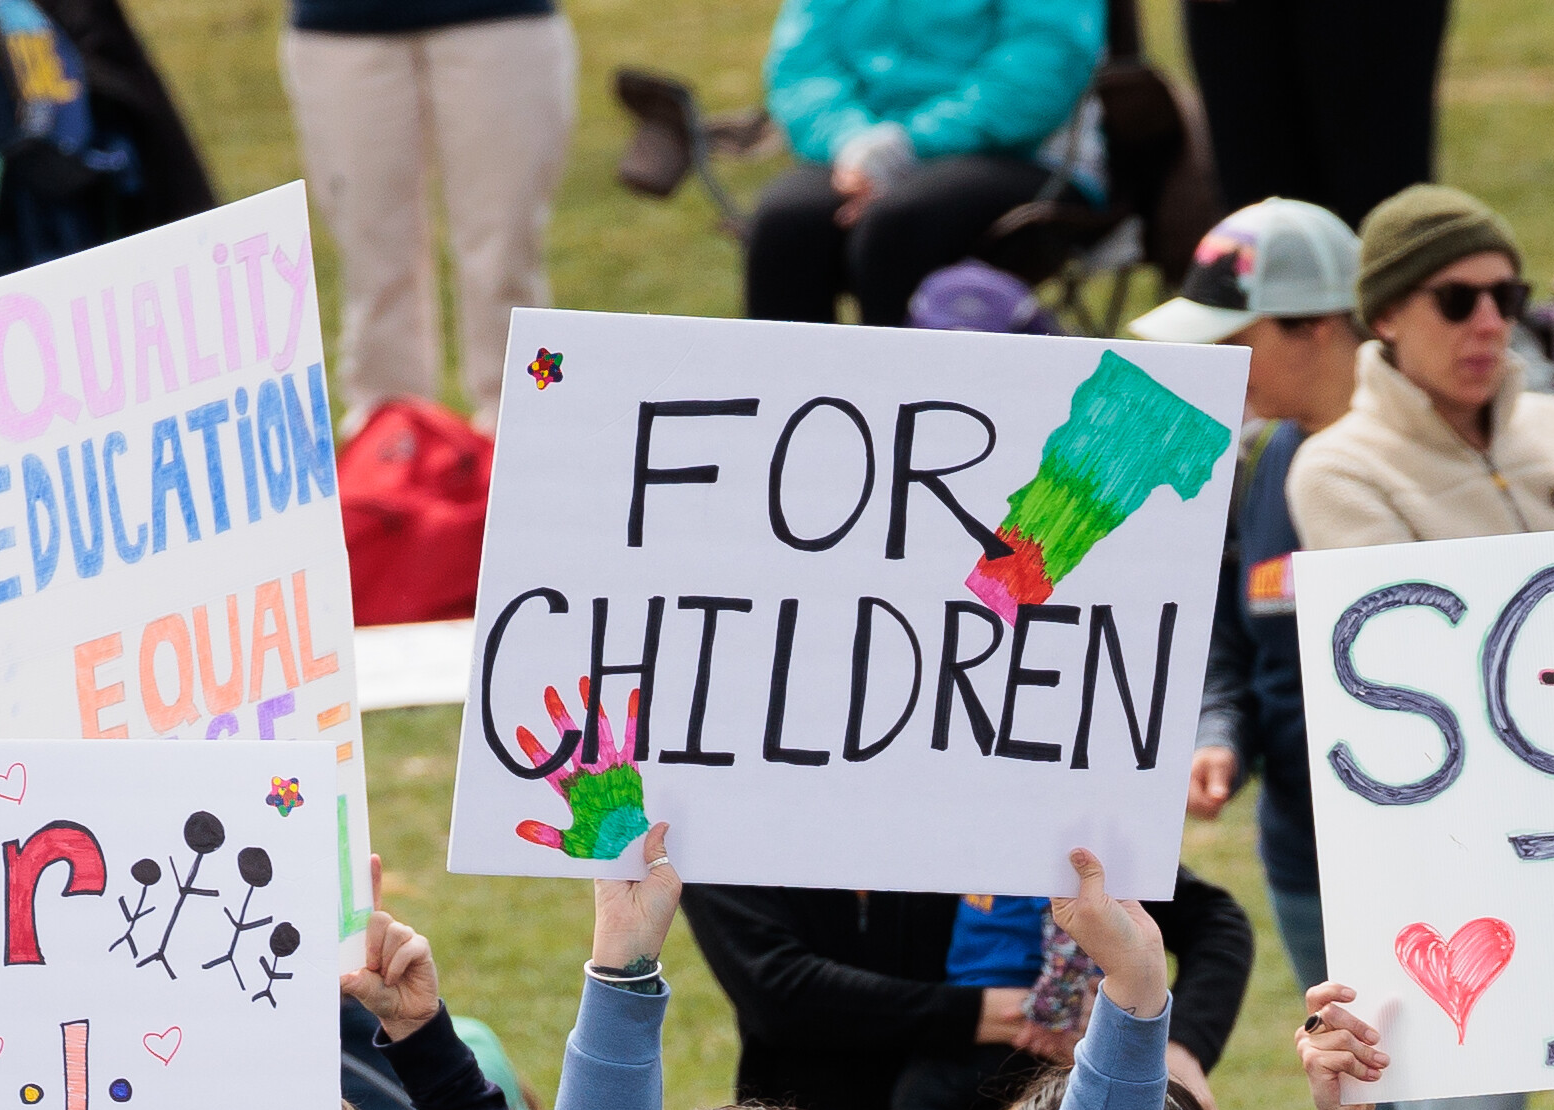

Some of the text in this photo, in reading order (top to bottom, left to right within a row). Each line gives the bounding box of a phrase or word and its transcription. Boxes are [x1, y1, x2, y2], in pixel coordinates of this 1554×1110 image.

[627, 396, 1016, 561] FOR
[73, 568, 341, 740] EQUAL
[481, 587, 1178, 780] CHILDREN
